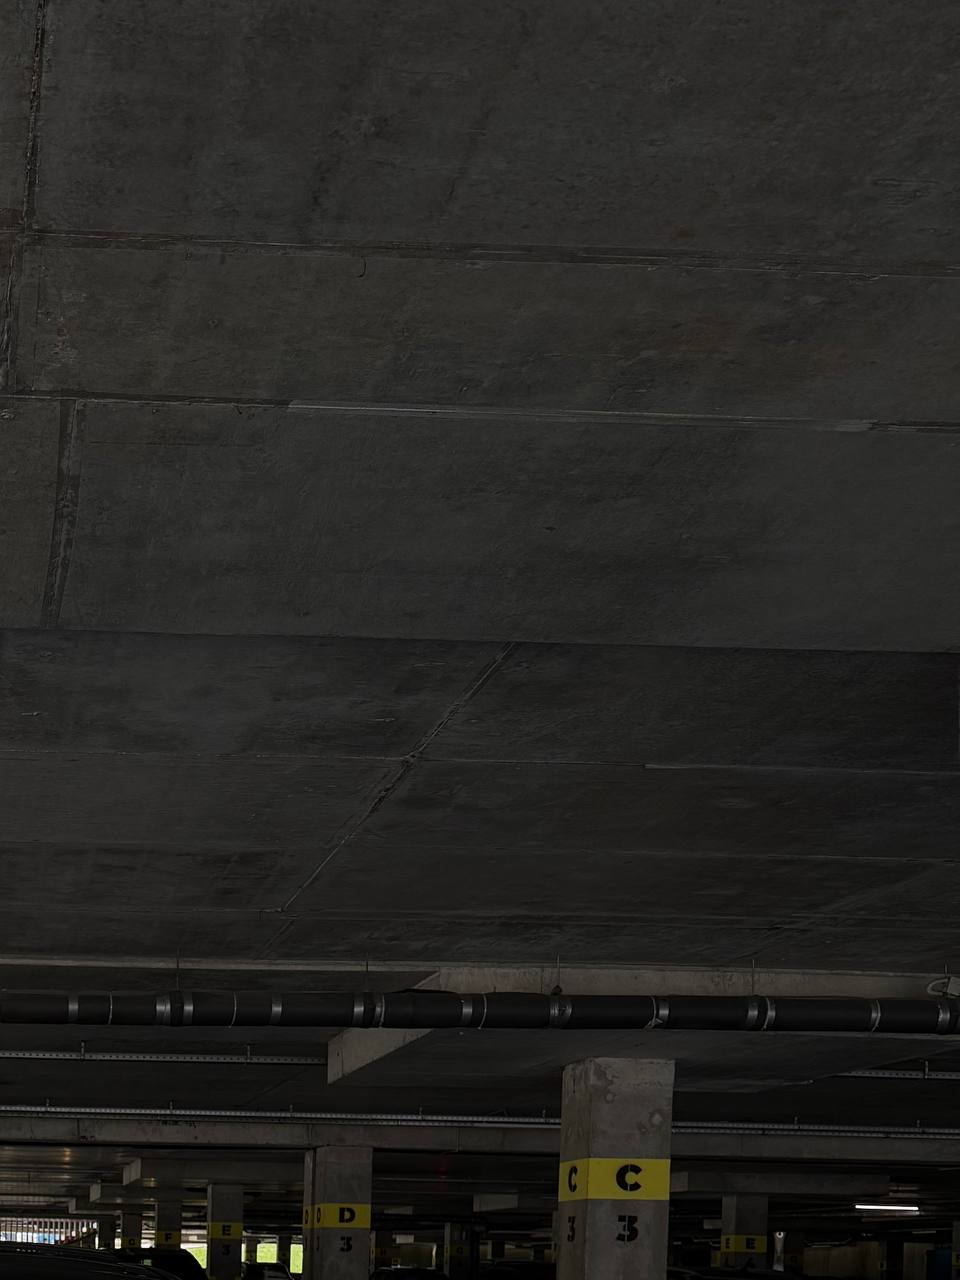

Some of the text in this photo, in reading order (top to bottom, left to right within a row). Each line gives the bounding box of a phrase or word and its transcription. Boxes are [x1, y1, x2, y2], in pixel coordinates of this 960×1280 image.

[568, 1166, 577, 1192] C
[616, 1164, 642, 1191] C
[339, 1207, 356, 1223] D
[222, 1225, 231, 1236] E
[616, 1215, 638, 1242] 3
[165, 1233, 172, 1242] F
[340, 1236, 353, 1251] 3
[746, 1238, 755, 1249] E
[222, 1245, 231, 1255] 3
